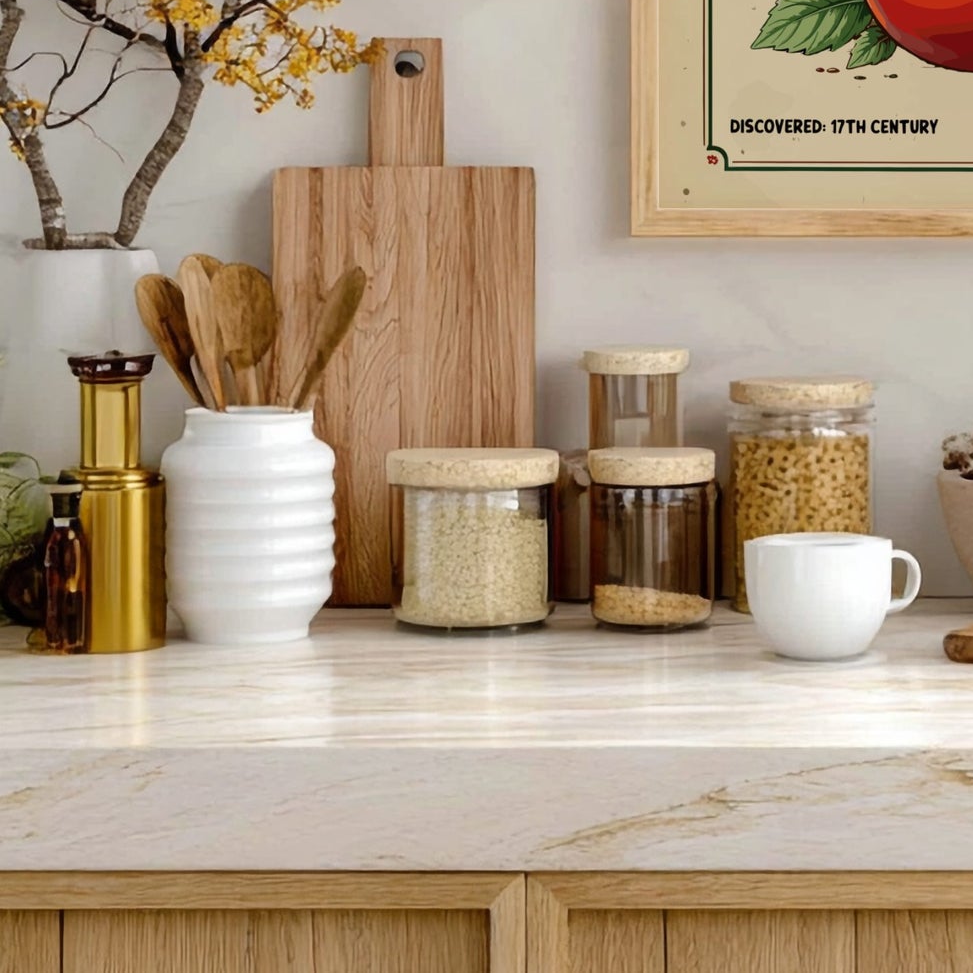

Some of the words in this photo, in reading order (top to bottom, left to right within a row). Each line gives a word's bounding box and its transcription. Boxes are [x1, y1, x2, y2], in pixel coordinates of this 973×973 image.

[730, 118, 826, 134] DISCOVERED:
[830, 118, 867, 134] 17TH
[870, 118, 939, 135] CENTURY
